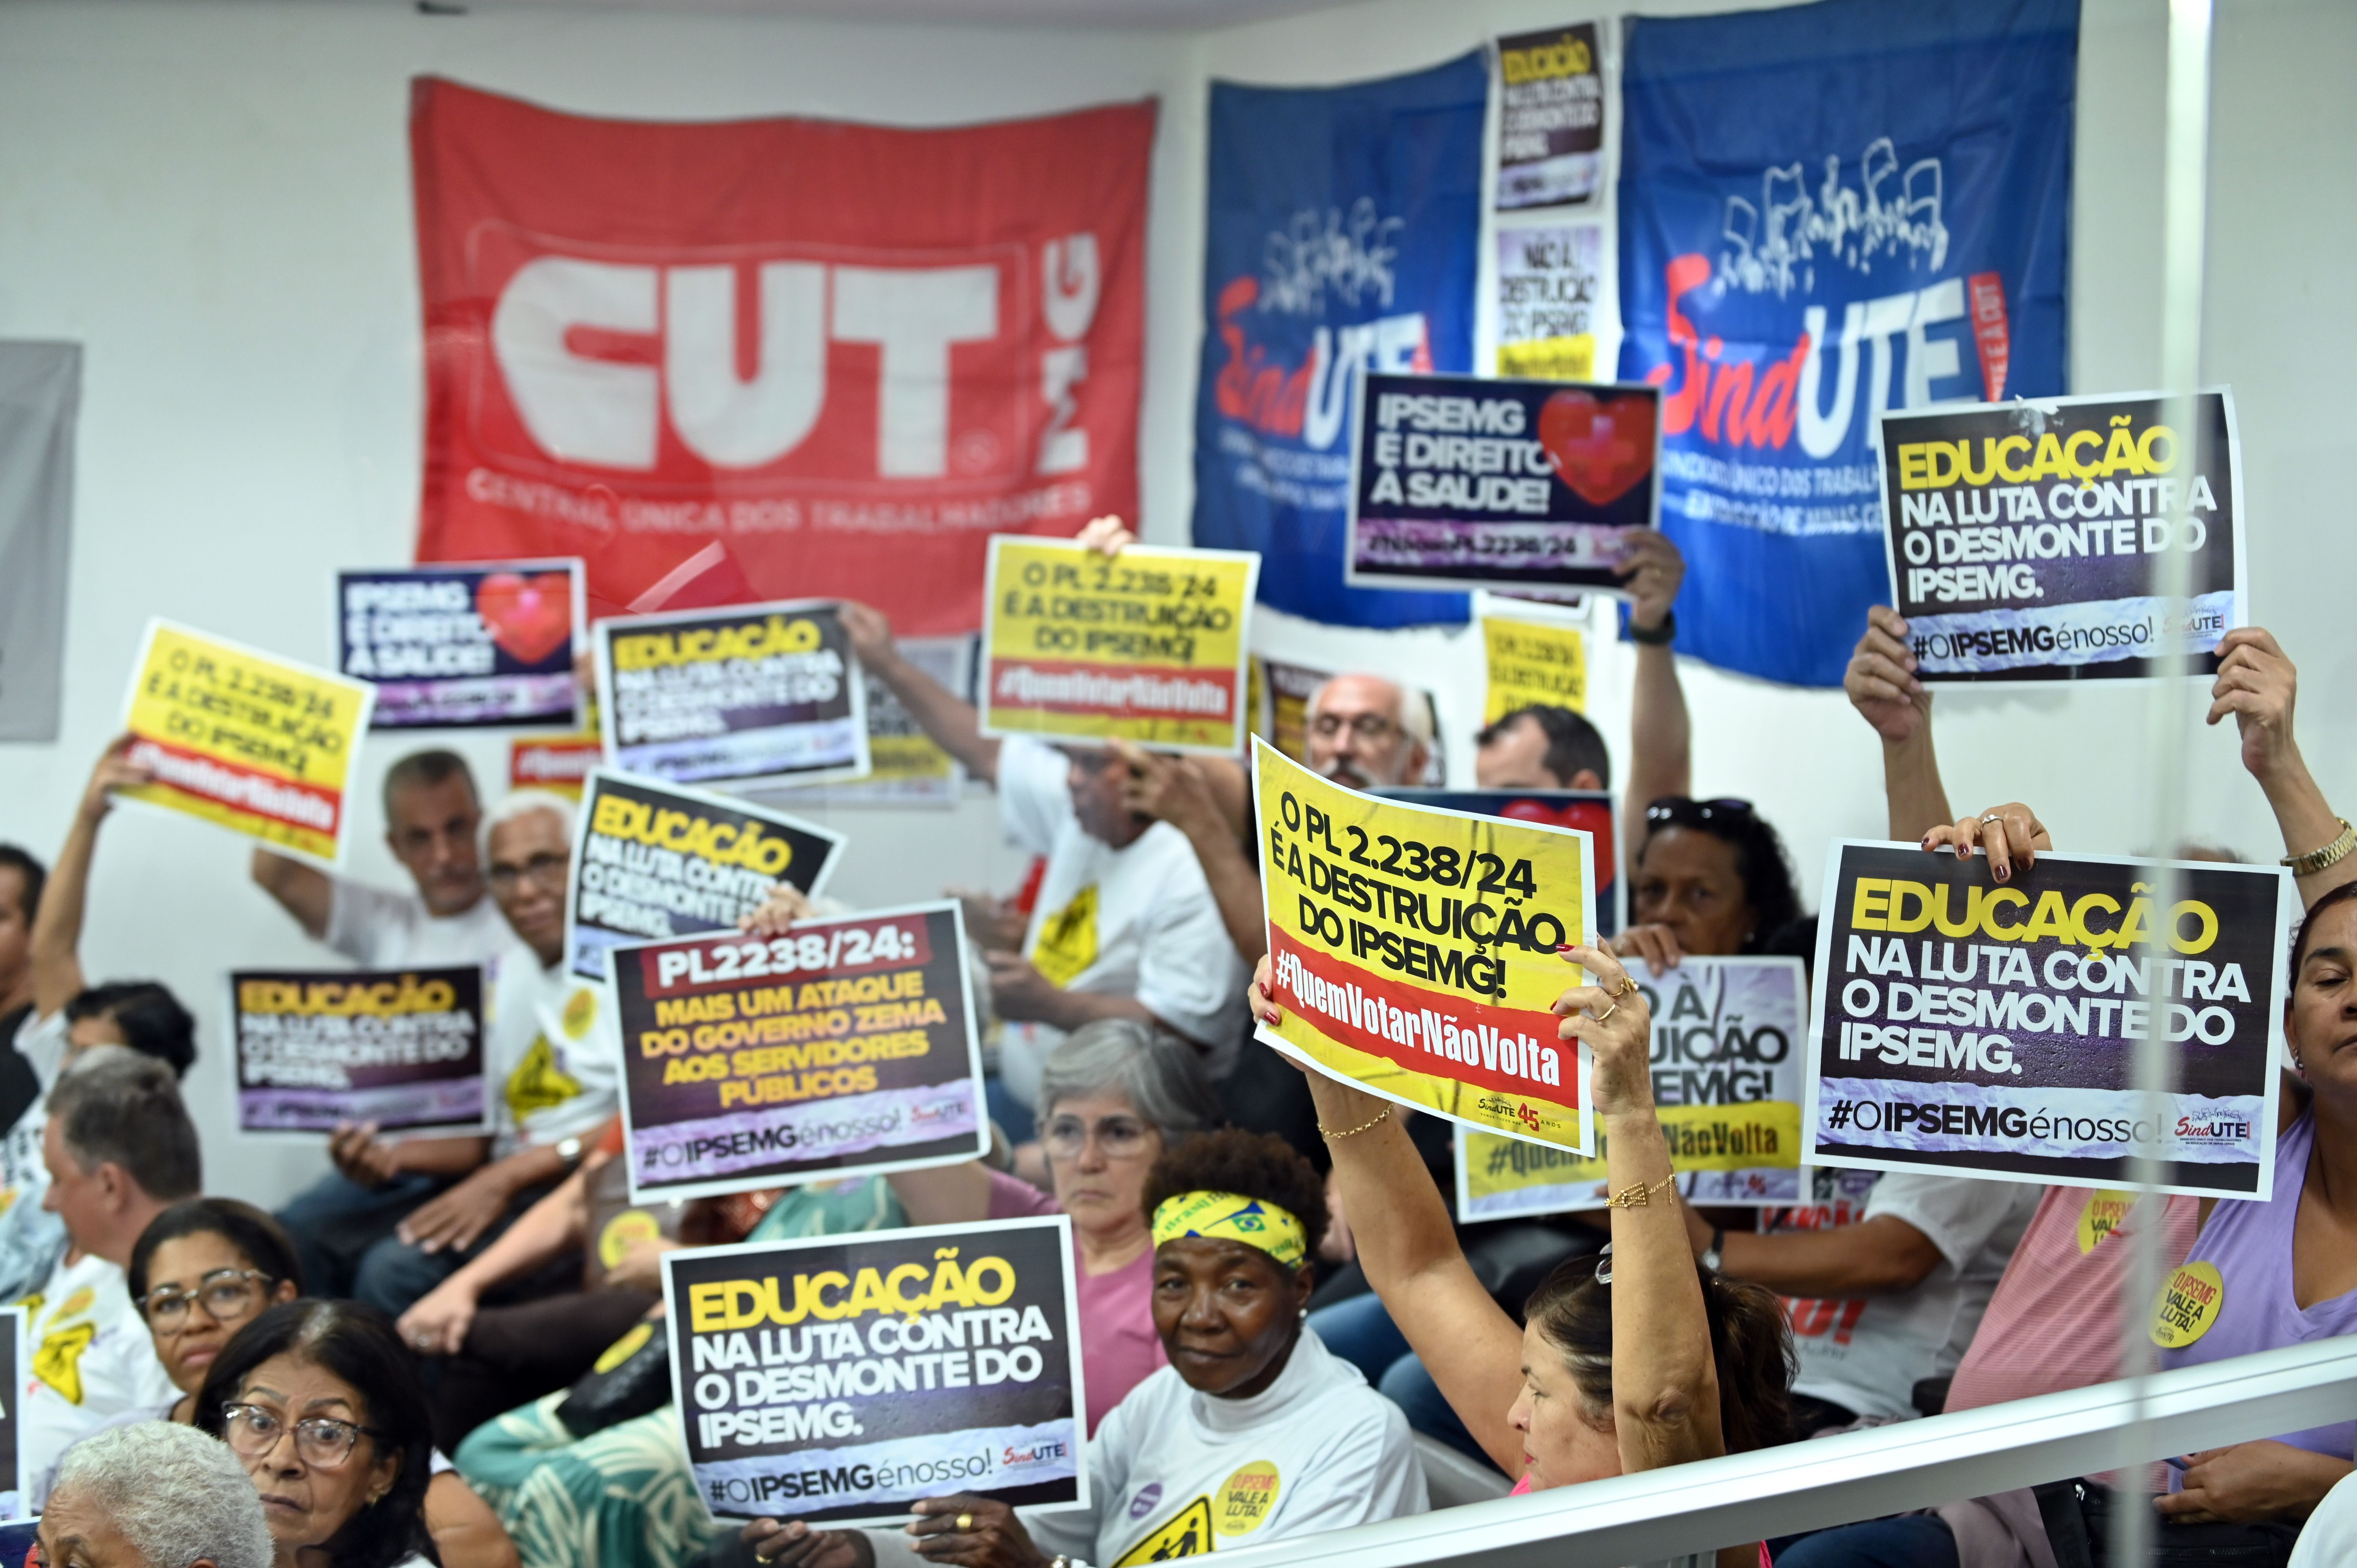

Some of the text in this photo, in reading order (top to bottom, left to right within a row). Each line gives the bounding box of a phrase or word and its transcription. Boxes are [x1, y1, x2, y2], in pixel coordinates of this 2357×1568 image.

[491, 254, 998, 479] CUT
[1037, 233, 1099, 474] MG
[1376, 392, 1527, 436] IPSEMG
[1898, 415, 2181, 490] EDUCAÇÃO
[1900, 491, 1952, 528] NA
[1956, 486, 2045, 523] LUTA
[2048, 476, 2217, 520] CONTRA
[1904, 517, 2207, 565] O DESMONTE DO
[1022, 561, 1046, 586] O
[1909, 564, 2044, 603] IPSEMG.
[1035, 625, 1079, 652] DO
[590, 793, 792, 876] EDUCAÇÃO
[1281, 790, 1537, 899] O PL 2.238/24
[1270, 821, 1566, 955] É A DESTRUIÇÃO
[1299, 893, 1507, 999] DO IPSEMG!
[1852, 878, 2219, 961] EDUCAÇÃO
[657, 924, 916, 988] PL2238/24:
[1846, 935, 2251, 1003] NA LUTA CONTRA
[640, 998, 947, 1059] DO GOVERNO ZEMA
[655, 971, 925, 1028] MAIS UM ATAQUE
[1276, 948, 1560, 1087] #QuemVotarNãoVolta
[1842, 979, 2236, 1046] O DESMONTE DO
[663, 1030, 930, 1085] AOS SERVIDORES
[1839, 1021, 2023, 1075] IPSEMG.
[1518, 1102, 1540, 1132] 45
[1541, 1119, 1561, 1129] ANOS
[1652, 1070, 1773, 1106] EMG!
[688, 1247, 1016, 1333] EDUCAÇÃO
[2165, 1289, 2204, 1321] VALE A
[2173, 1271, 2217, 1306] O IPSEMG
[691, 1305, 1053, 1372] NA LUTA CONTRA
[2159, 1305, 2196, 1333] LUTA!
[694, 1346, 1044, 1410] O DESMONTE DO
[698, 1402, 865, 1449] IPSEMG.
[1228, 1491, 1269, 1504] VALE A
